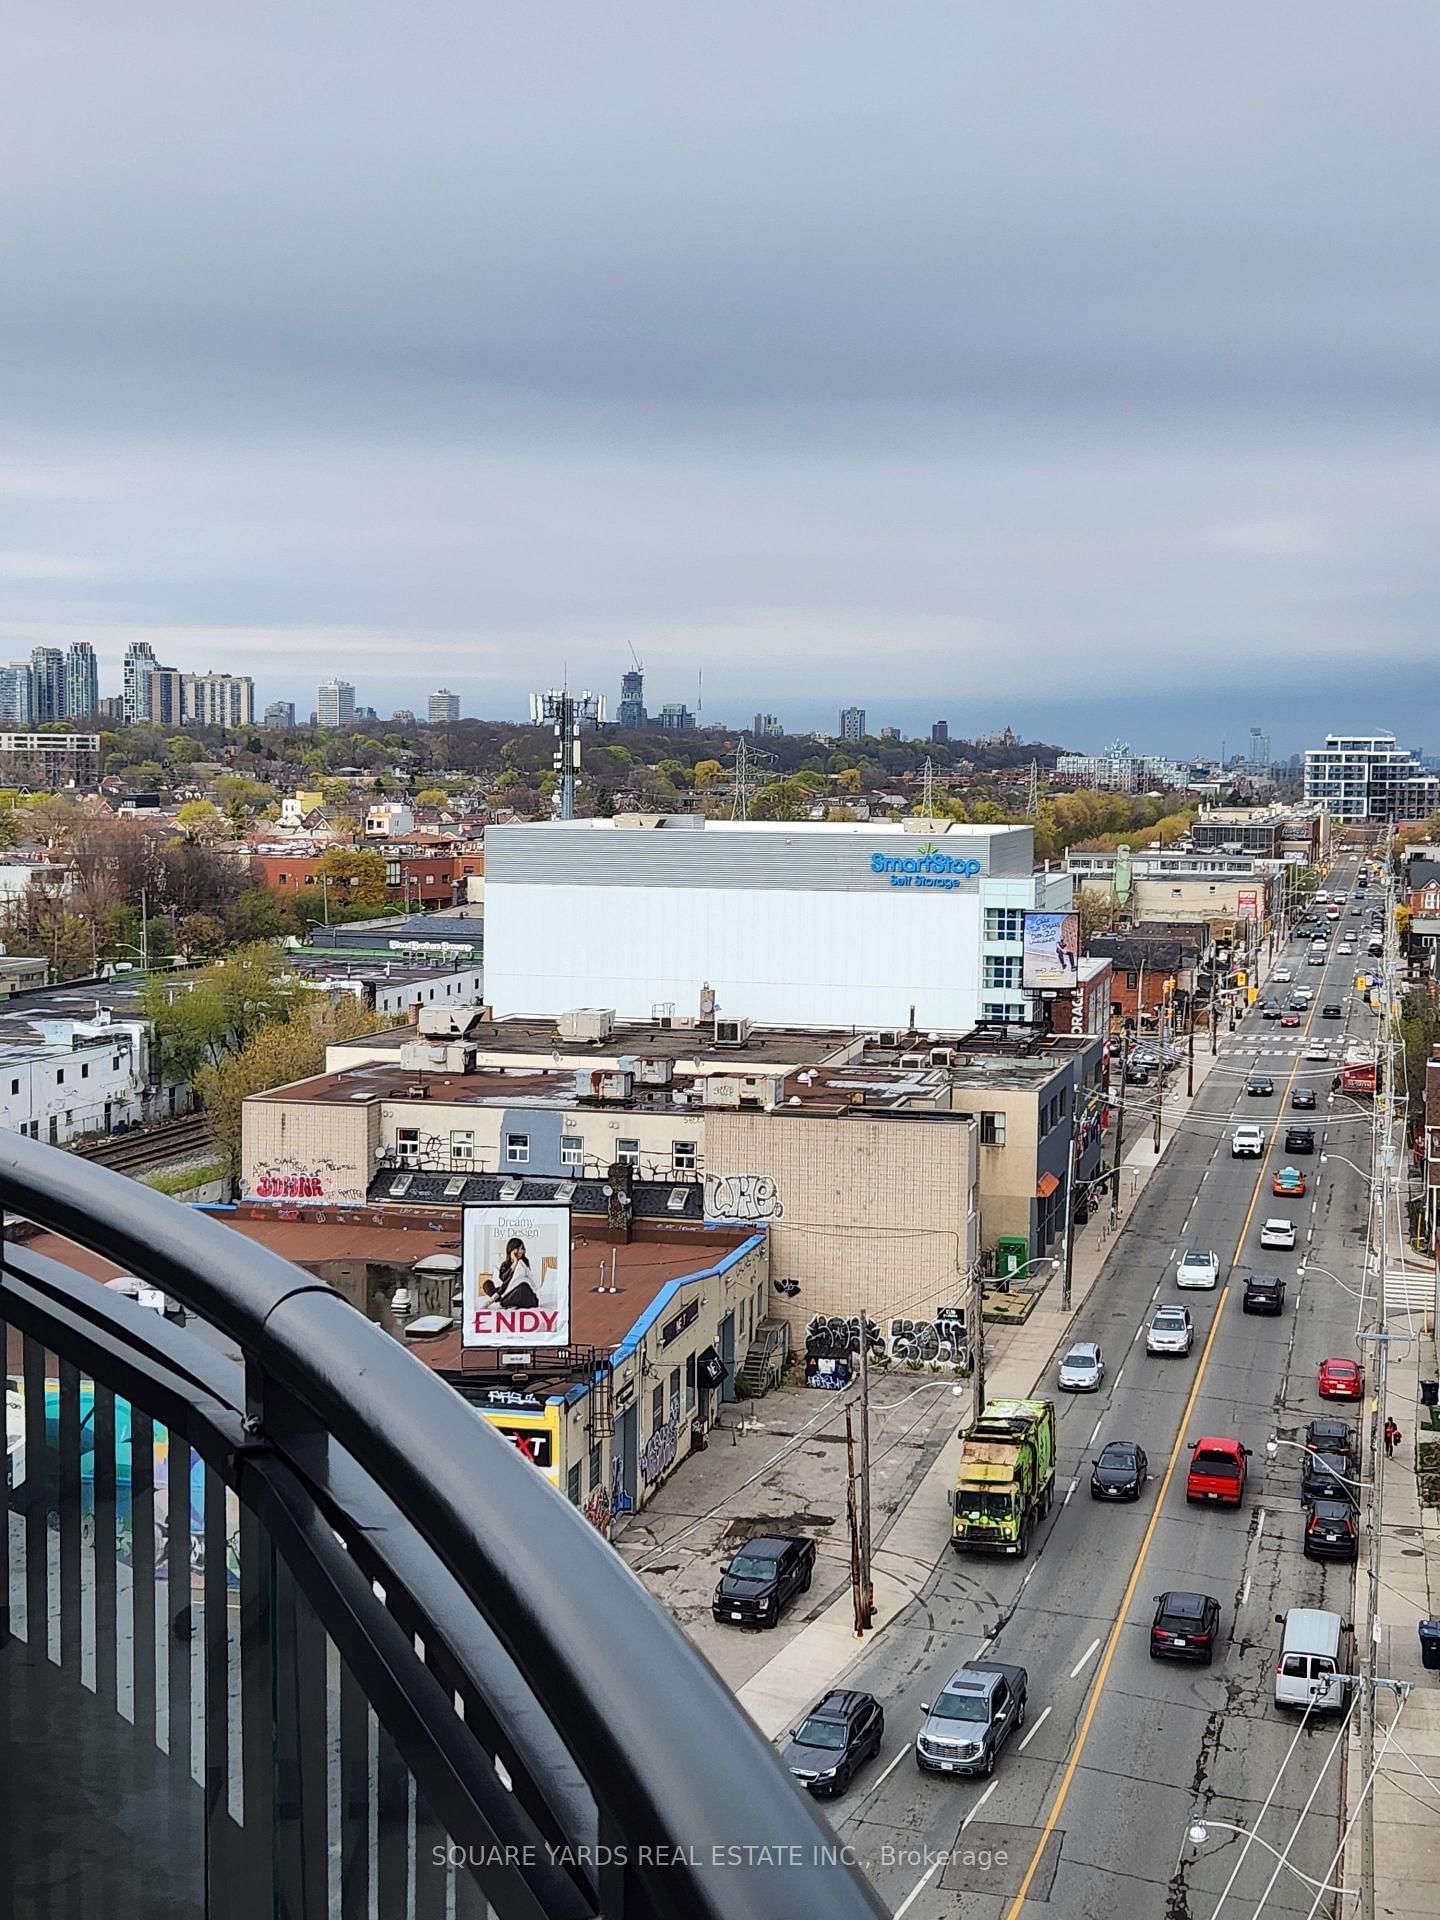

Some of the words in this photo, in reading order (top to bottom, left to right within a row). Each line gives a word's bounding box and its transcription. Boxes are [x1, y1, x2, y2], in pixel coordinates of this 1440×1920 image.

[871, 853, 981, 878] SmartStop
[890, 874, 912, 887] Self
[914, 876, 961, 890] Storage
[498, 1217, 534, 1228] Dreamy
[493, 1228, 506, 1238] By
[507, 1228, 539, 1238] Design
[473, 1311, 559, 1333] ENDY
